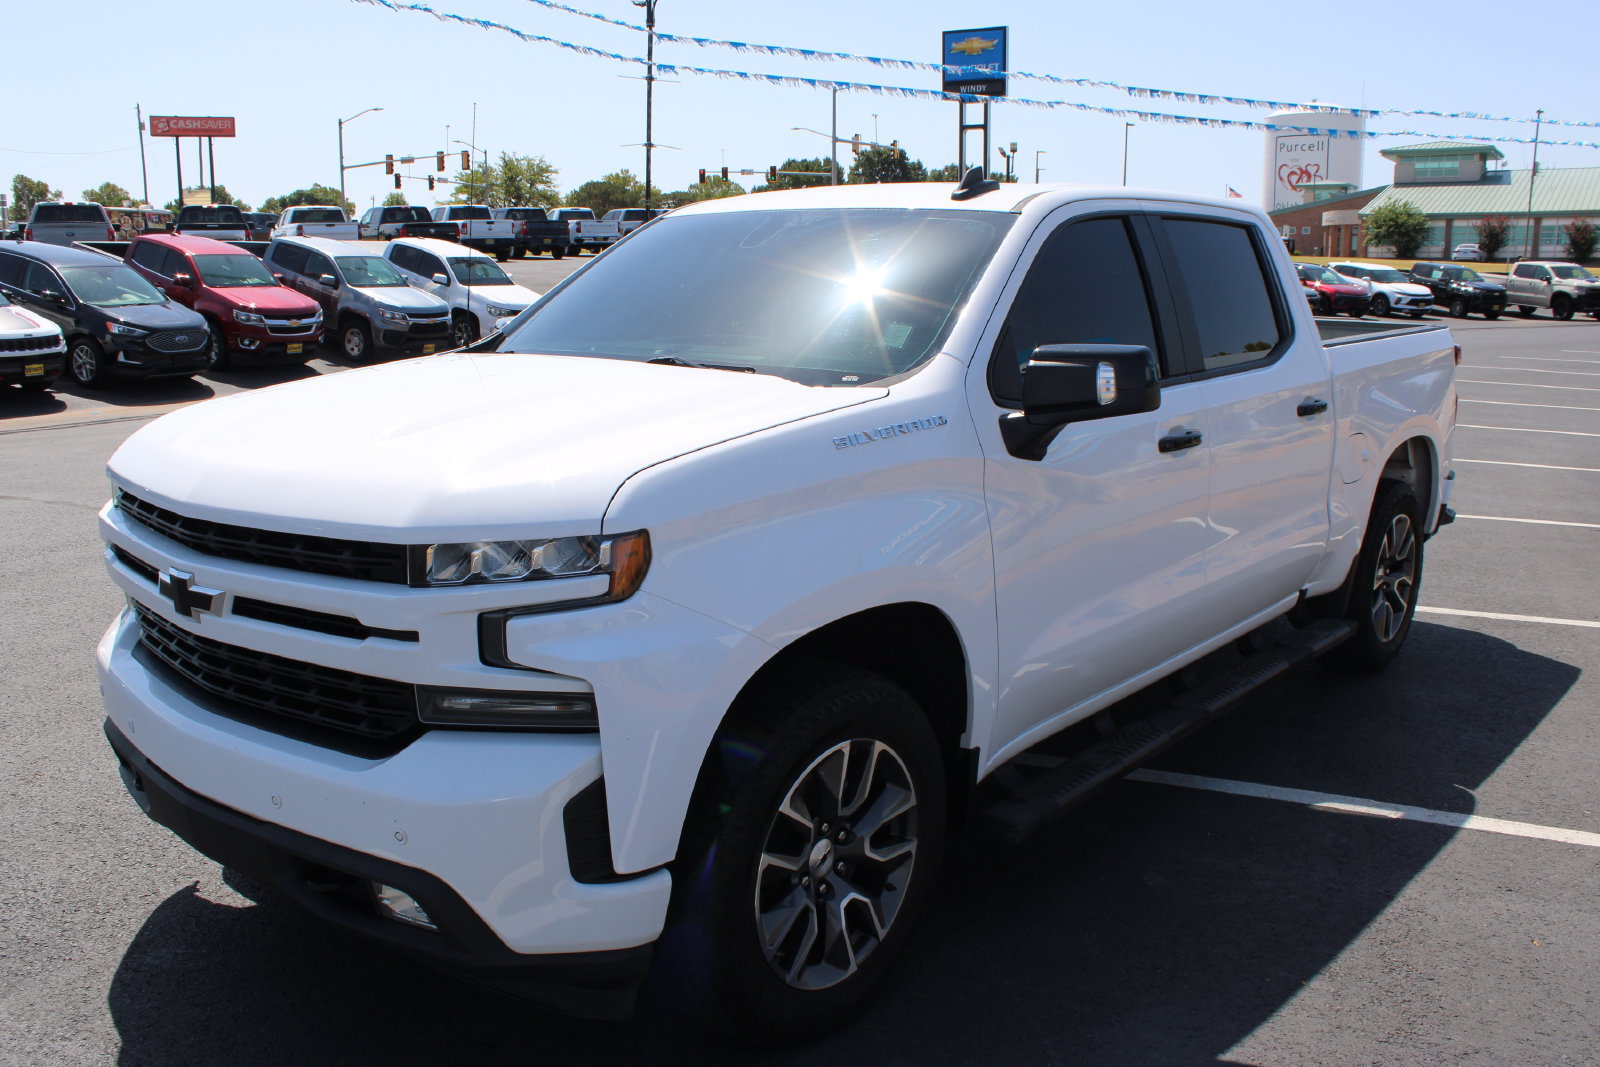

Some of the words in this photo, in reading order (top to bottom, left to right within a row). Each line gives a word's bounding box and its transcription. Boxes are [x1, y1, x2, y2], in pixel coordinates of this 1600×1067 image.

[960, 84, 987, 93] WINDY
[1279, 140, 1324, 153] Purcell
[832, 415, 948, 450] SILVERADO
